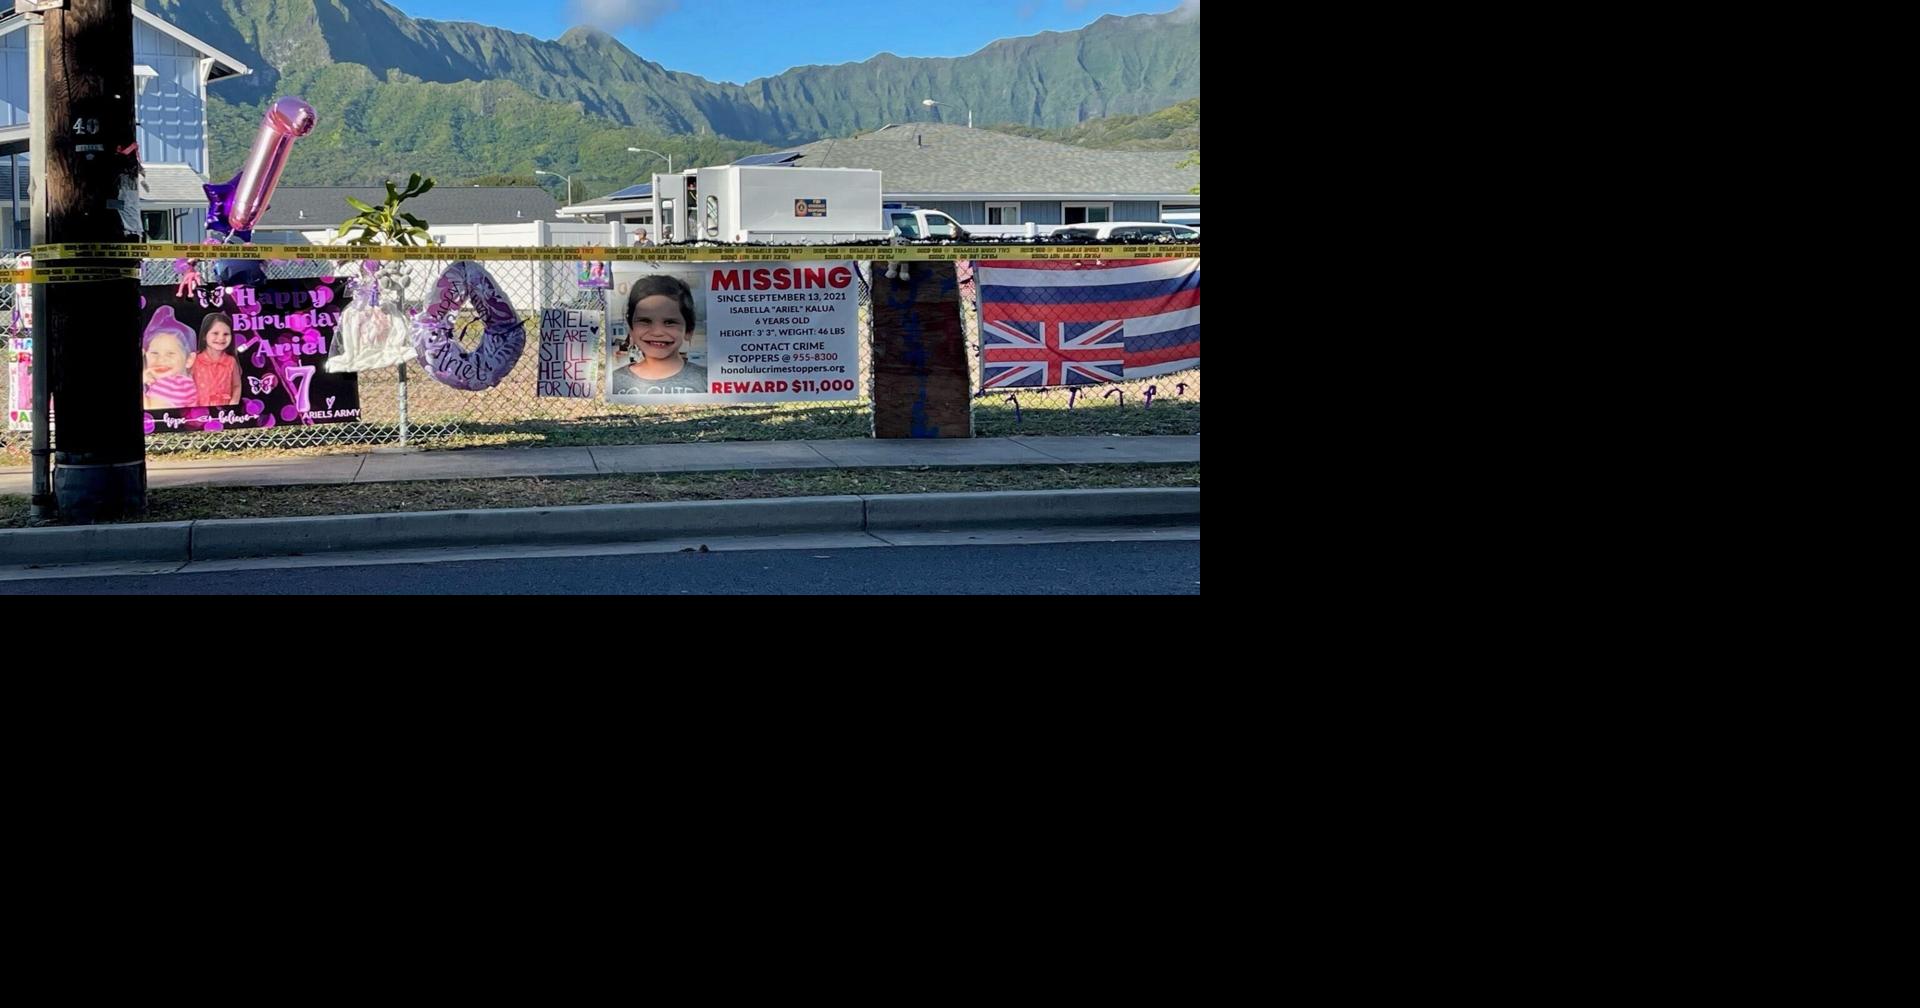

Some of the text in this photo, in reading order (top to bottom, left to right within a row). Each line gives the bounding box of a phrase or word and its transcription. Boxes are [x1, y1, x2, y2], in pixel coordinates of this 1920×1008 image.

[711, 266, 852, 291] MISSING
[237, 287, 327, 309] Happy
[717, 292, 846, 303] SINCE SEPTEMBER 13, 2021
[730, 305, 835, 314] ISABELLA "ARIEL" KALUA
[541, 310, 594, 328] ARIEL:
[755, 317, 760, 325] 6
[762, 317, 790, 325] YEARS
[541, 330, 588, 342] WE ARE
[719, 329, 755, 337] HEIGHT:
[757, 329, 765, 337] 3'
[779, 328, 816, 336] WEIGHT:
[817, 328, 829, 336] 46
[830, 327, 845, 335] LBS
[256, 336, 327, 358] Ariel
[540, 342, 593, 361] STILL
[740, 342, 825, 352] CONTACT CRIME
[727, 353, 838, 363] STOPPERS @ 955-8300
[539, 361, 586, 380] HERE
[720, 365, 845, 375] honolulucrimestoppers.org
[285, 366, 316, 412] 7
[538, 381, 592, 397] FOR YOU
[711, 379, 855, 394] REWARD $11,000
[302, 408, 361, 419] ARIELS ARMY
